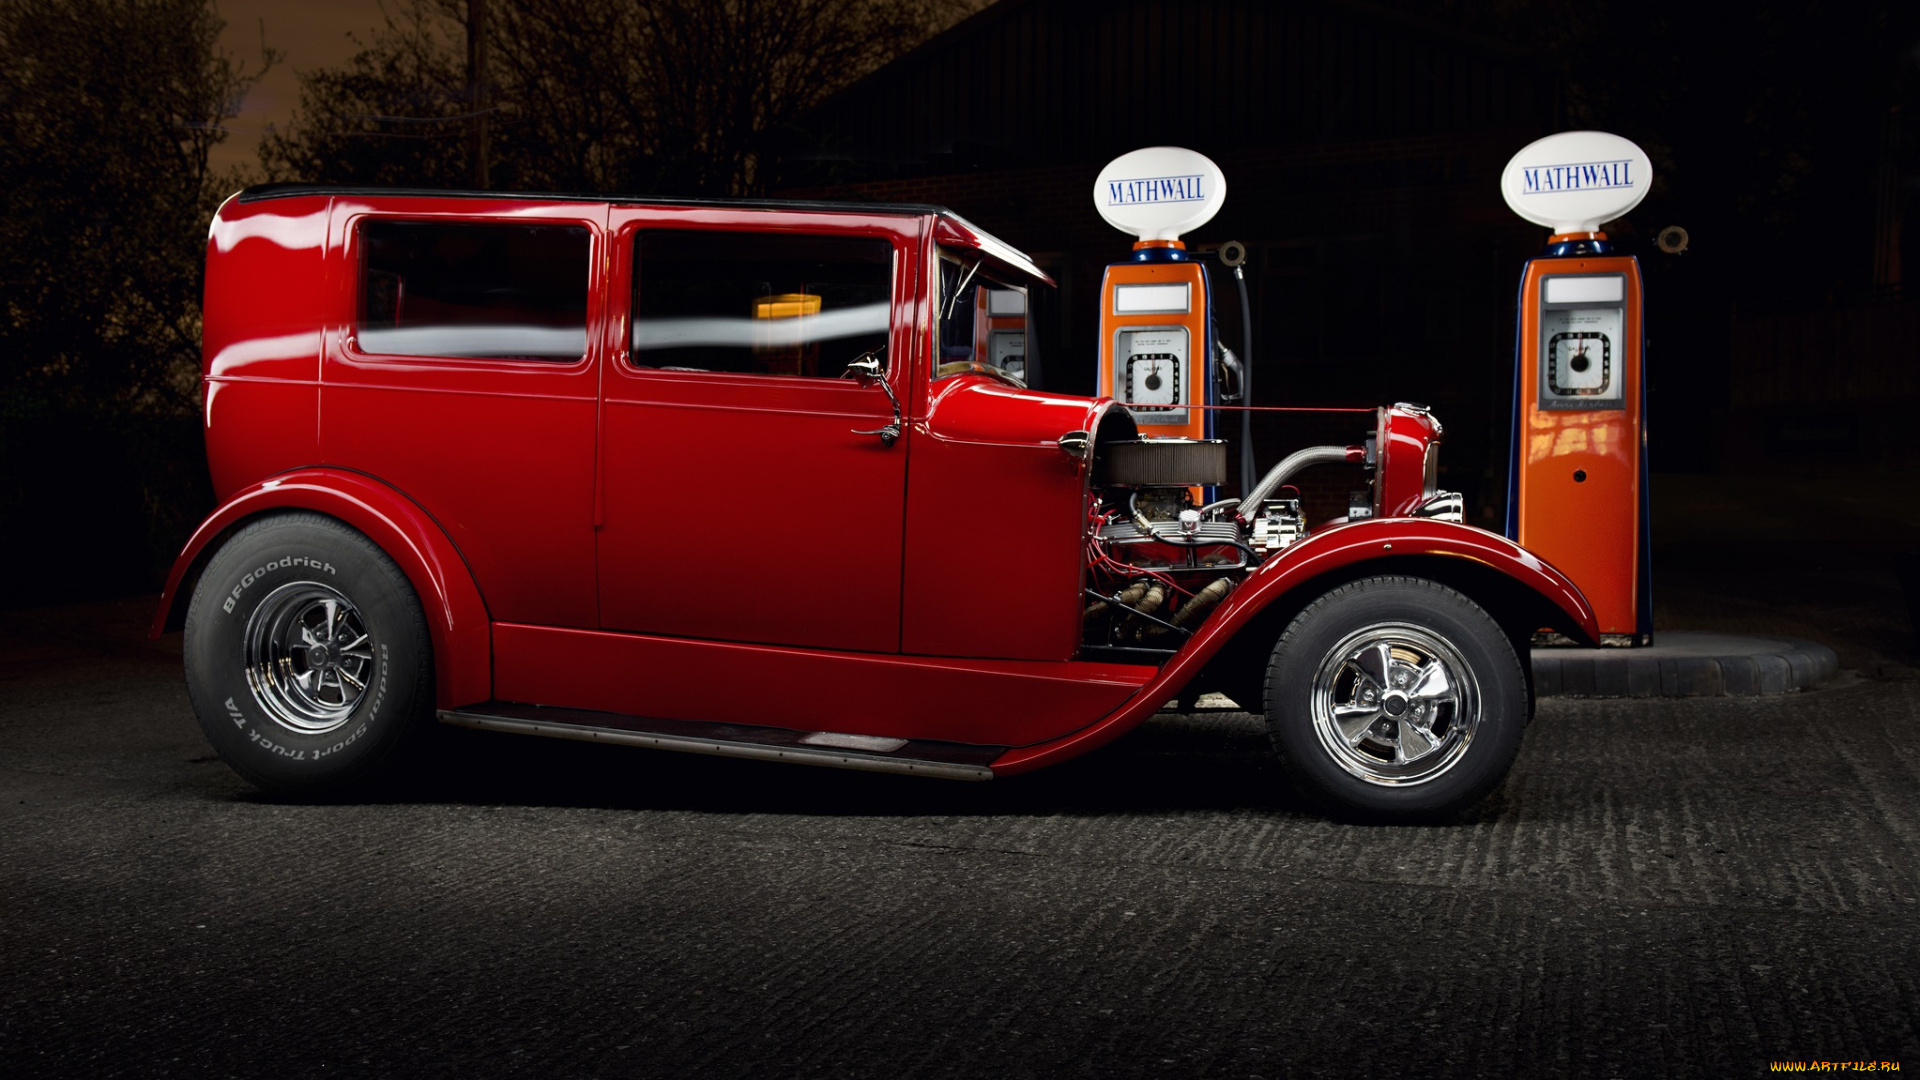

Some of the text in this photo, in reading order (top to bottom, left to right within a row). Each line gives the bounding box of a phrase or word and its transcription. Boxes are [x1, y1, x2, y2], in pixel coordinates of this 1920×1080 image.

[1108, 177, 1205, 204] MATHWALL
[1524, 162, 1634, 192] MATHWALL
[222, 555, 337, 615] BFGoodrich
[224, 643, 389, 761] Radial Sport Truck T/A
